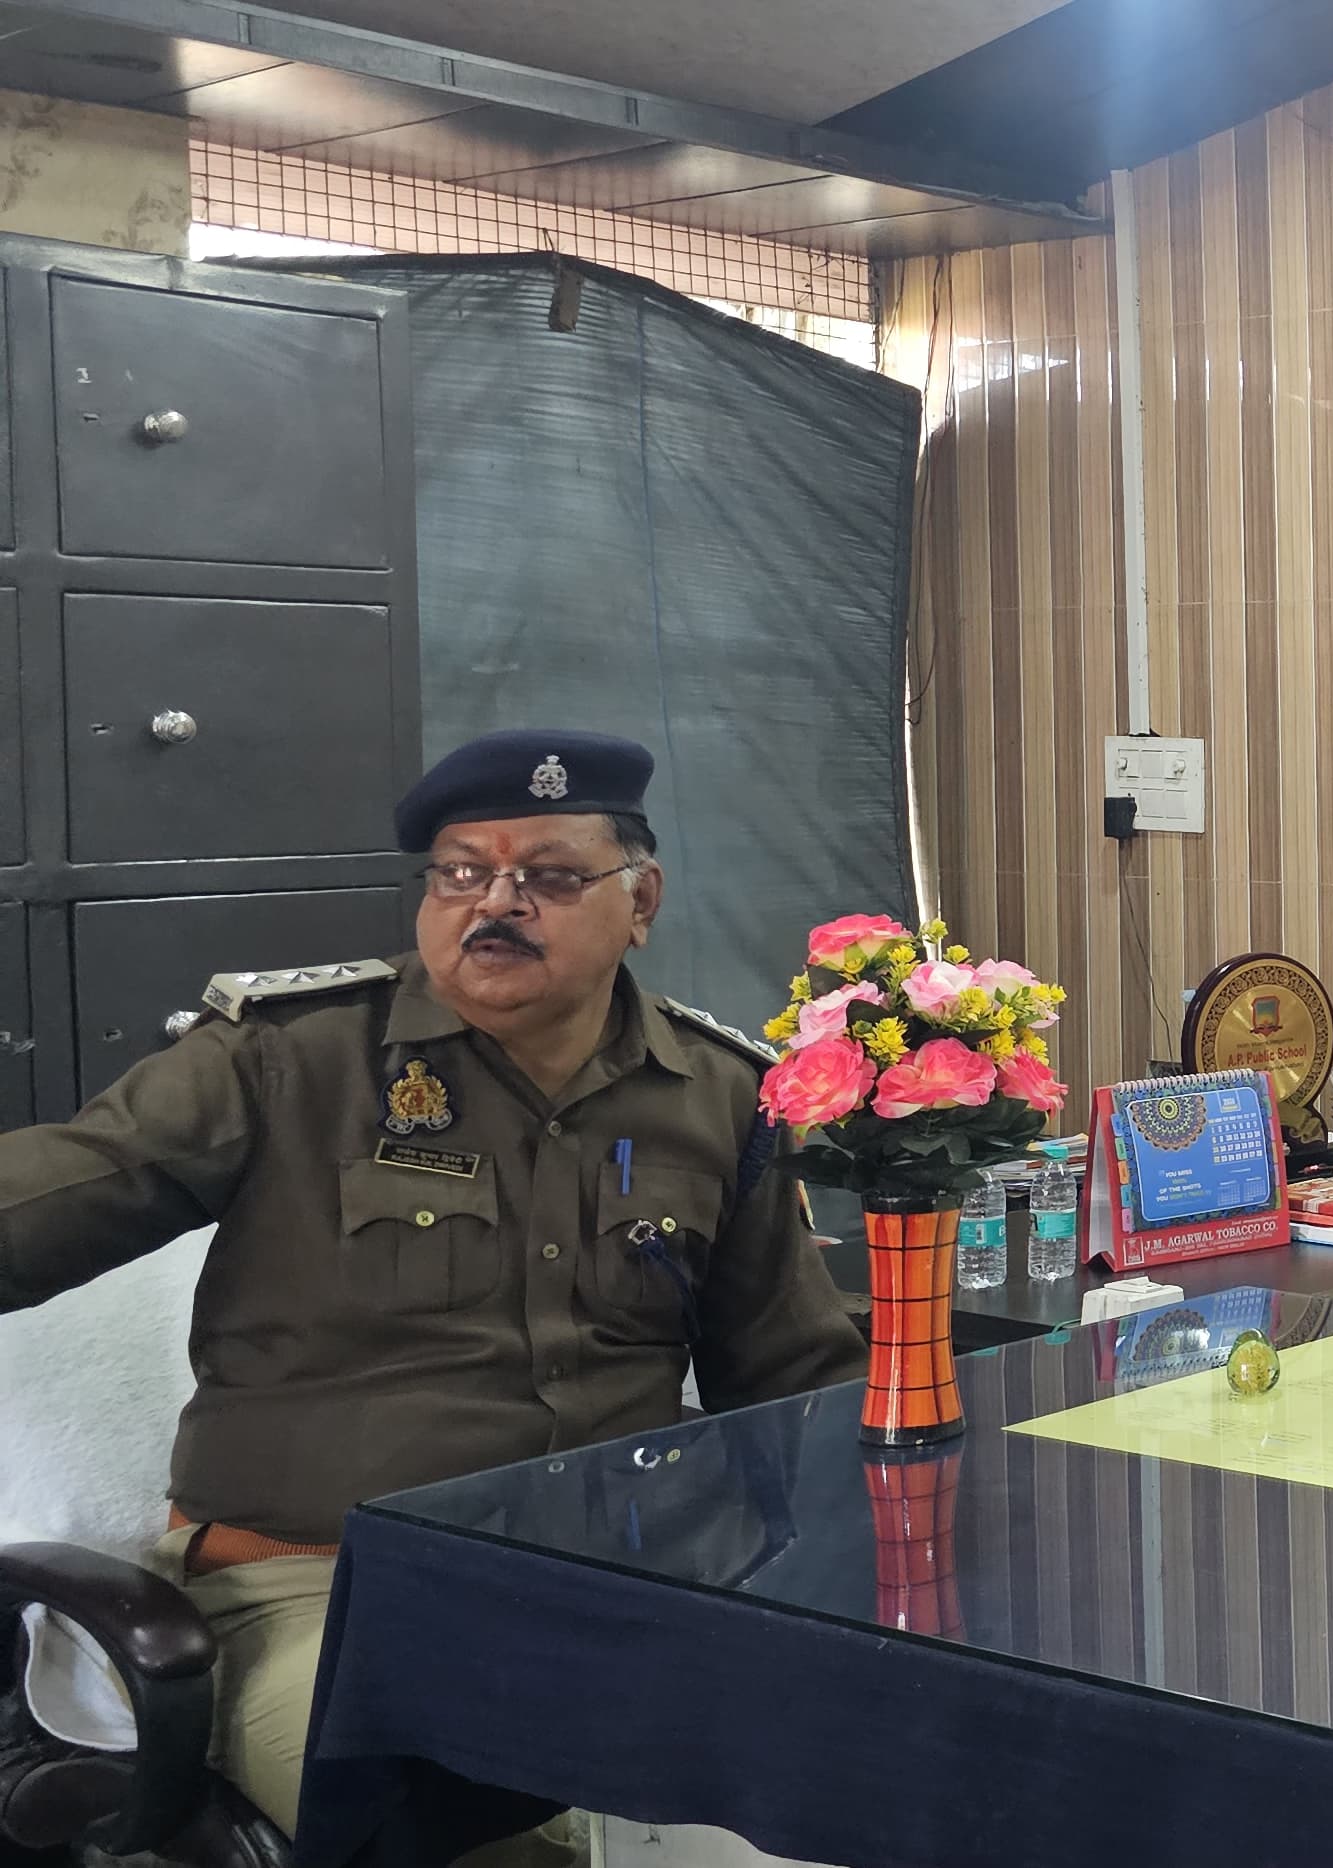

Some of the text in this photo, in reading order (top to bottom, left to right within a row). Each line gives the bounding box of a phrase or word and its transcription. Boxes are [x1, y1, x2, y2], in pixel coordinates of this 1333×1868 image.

[1227, 1053, 1245, 1067] A.P.
[1246, 1049, 1275, 1063] Public
[1277, 1043, 1307, 1060] School
[1144, 1238, 1166, 1252] J.M.
[1168, 1231, 1215, 1248] AGARWAL
[1216, 1223, 1262, 1239] TOBACCO
[1262, 1220, 1278, 1232] CO.
